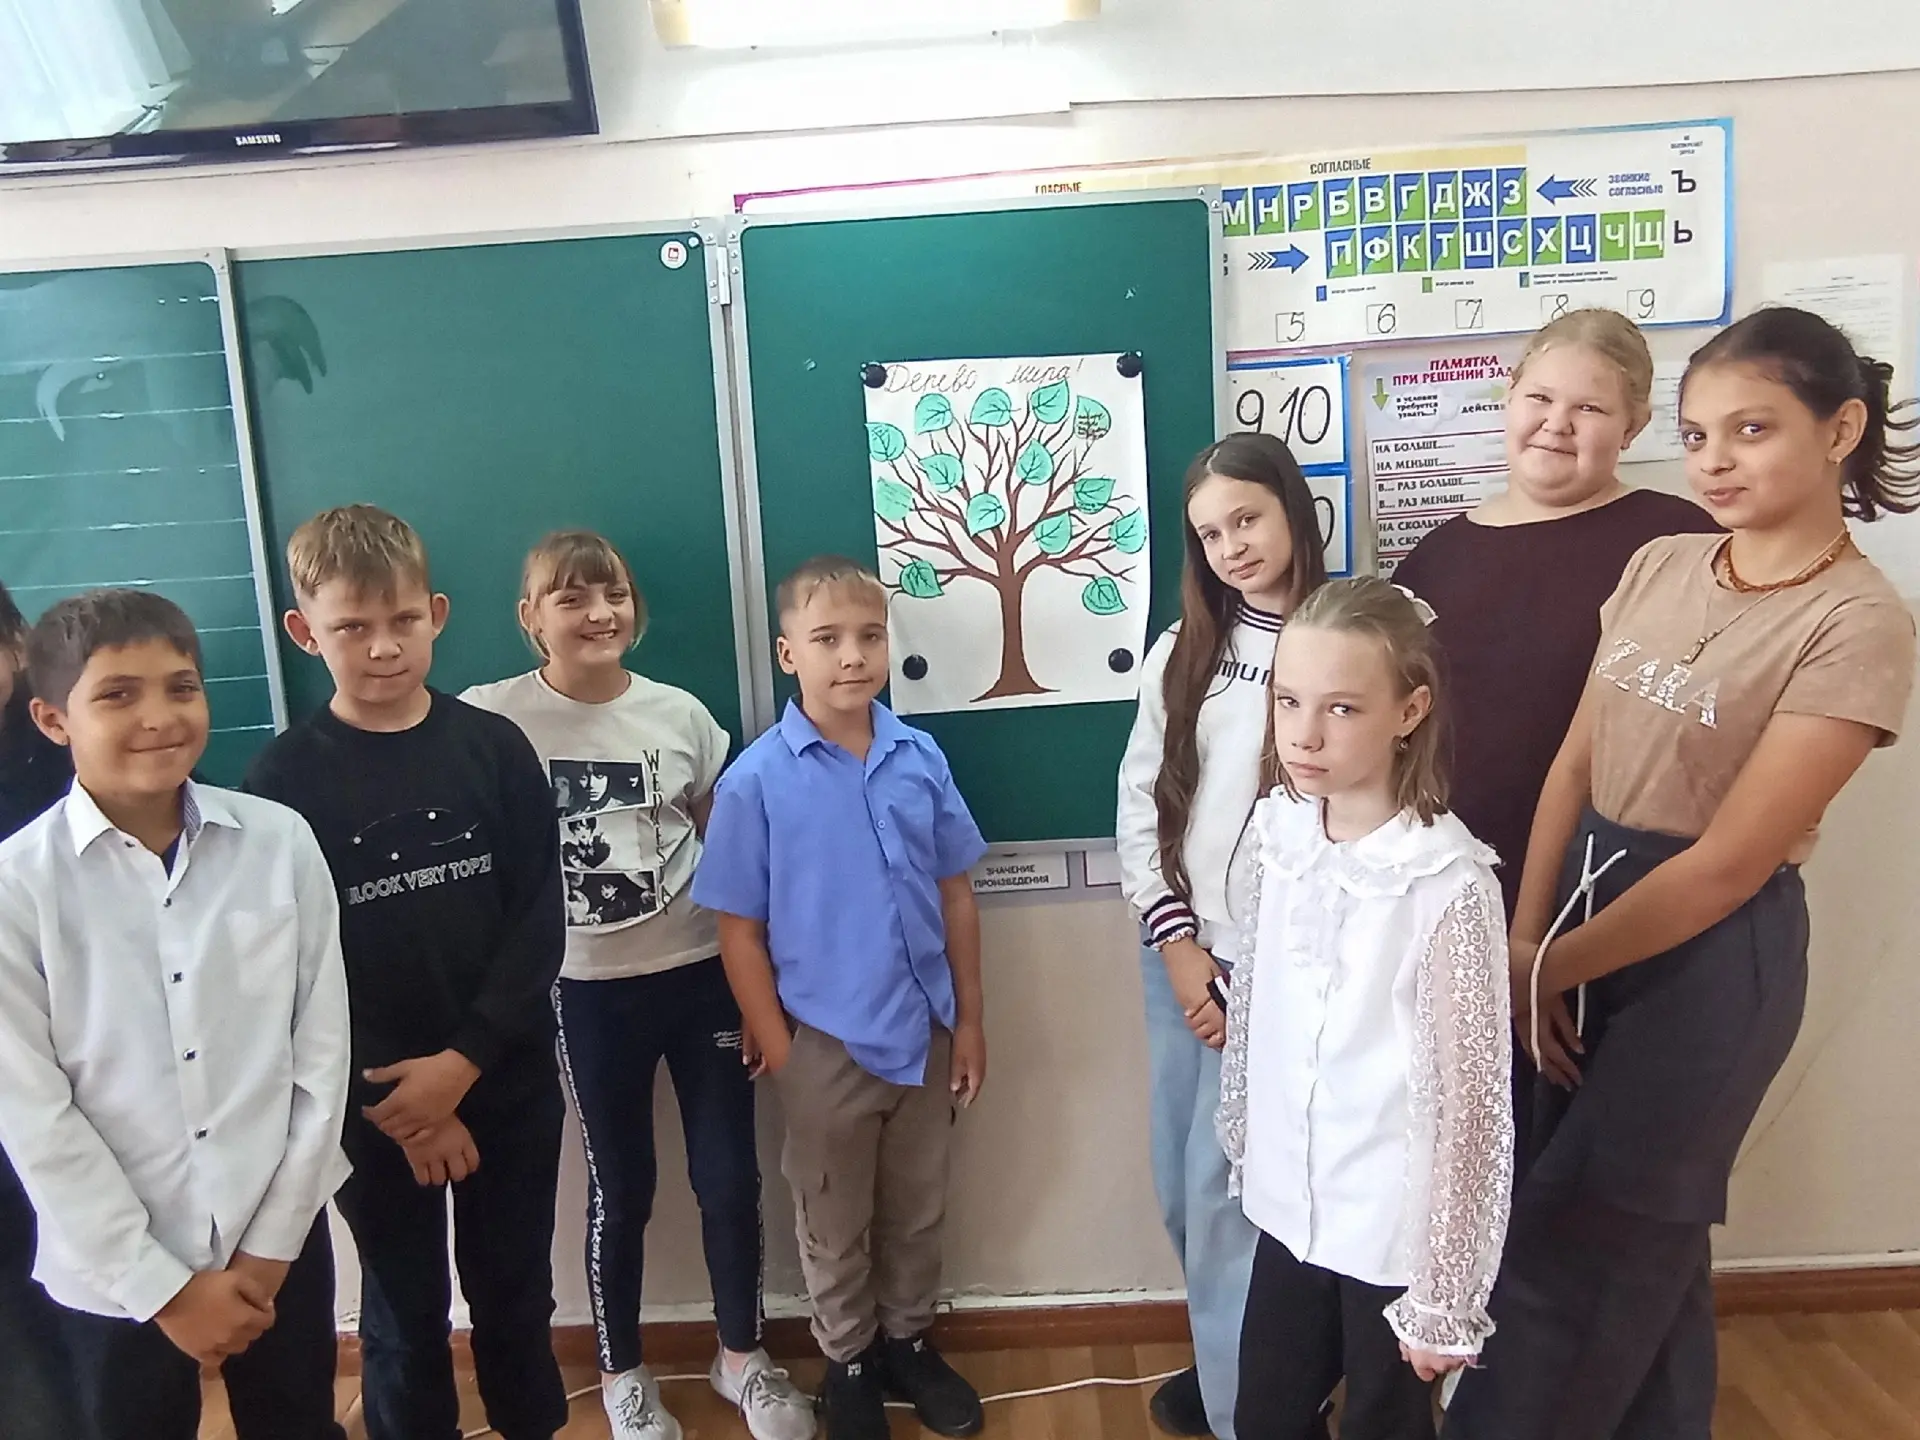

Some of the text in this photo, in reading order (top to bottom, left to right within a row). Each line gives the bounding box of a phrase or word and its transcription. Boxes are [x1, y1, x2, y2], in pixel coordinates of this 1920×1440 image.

[235, 134, 281, 146] SAMSUNG
[1310, 158, 1372, 174] СОГЛАСНЫЕ
[1671, 170, 1697, 193] Ъ
[1223, 179, 1521, 226] М Н Р Б В Г Д Ж З
[1331, 221, 1663, 267] П Ф К Т Ш С Х Ц Ч Щ
[1287, 289, 1655, 342] 5 6 7 8 9
[1430, 355, 1499, 371] ПАМЯТКА
[1393, 374, 1419, 386] ПРИ
[1422, 370, 1484, 384] РЕШЕНИИ
[1397, 402, 1438, 411] требуется
[1279, 385, 1331, 445] 10
[1375, 445, 1390, 454] НА
[1376, 462, 1392, 471] НА
[1398, 481, 1417, 491] РАЗ
[1398, 498, 1417, 507] РАЗ
[1379, 523, 1394, 532] НА
[1379, 538, 1395, 547] НА
[986, 864, 1036, 875] ЗНАЧЕНИЕ
[403, 864, 447, 891] VERY
[974, 874, 1049, 888] ПРОИЗВЕДЕНИЯ
